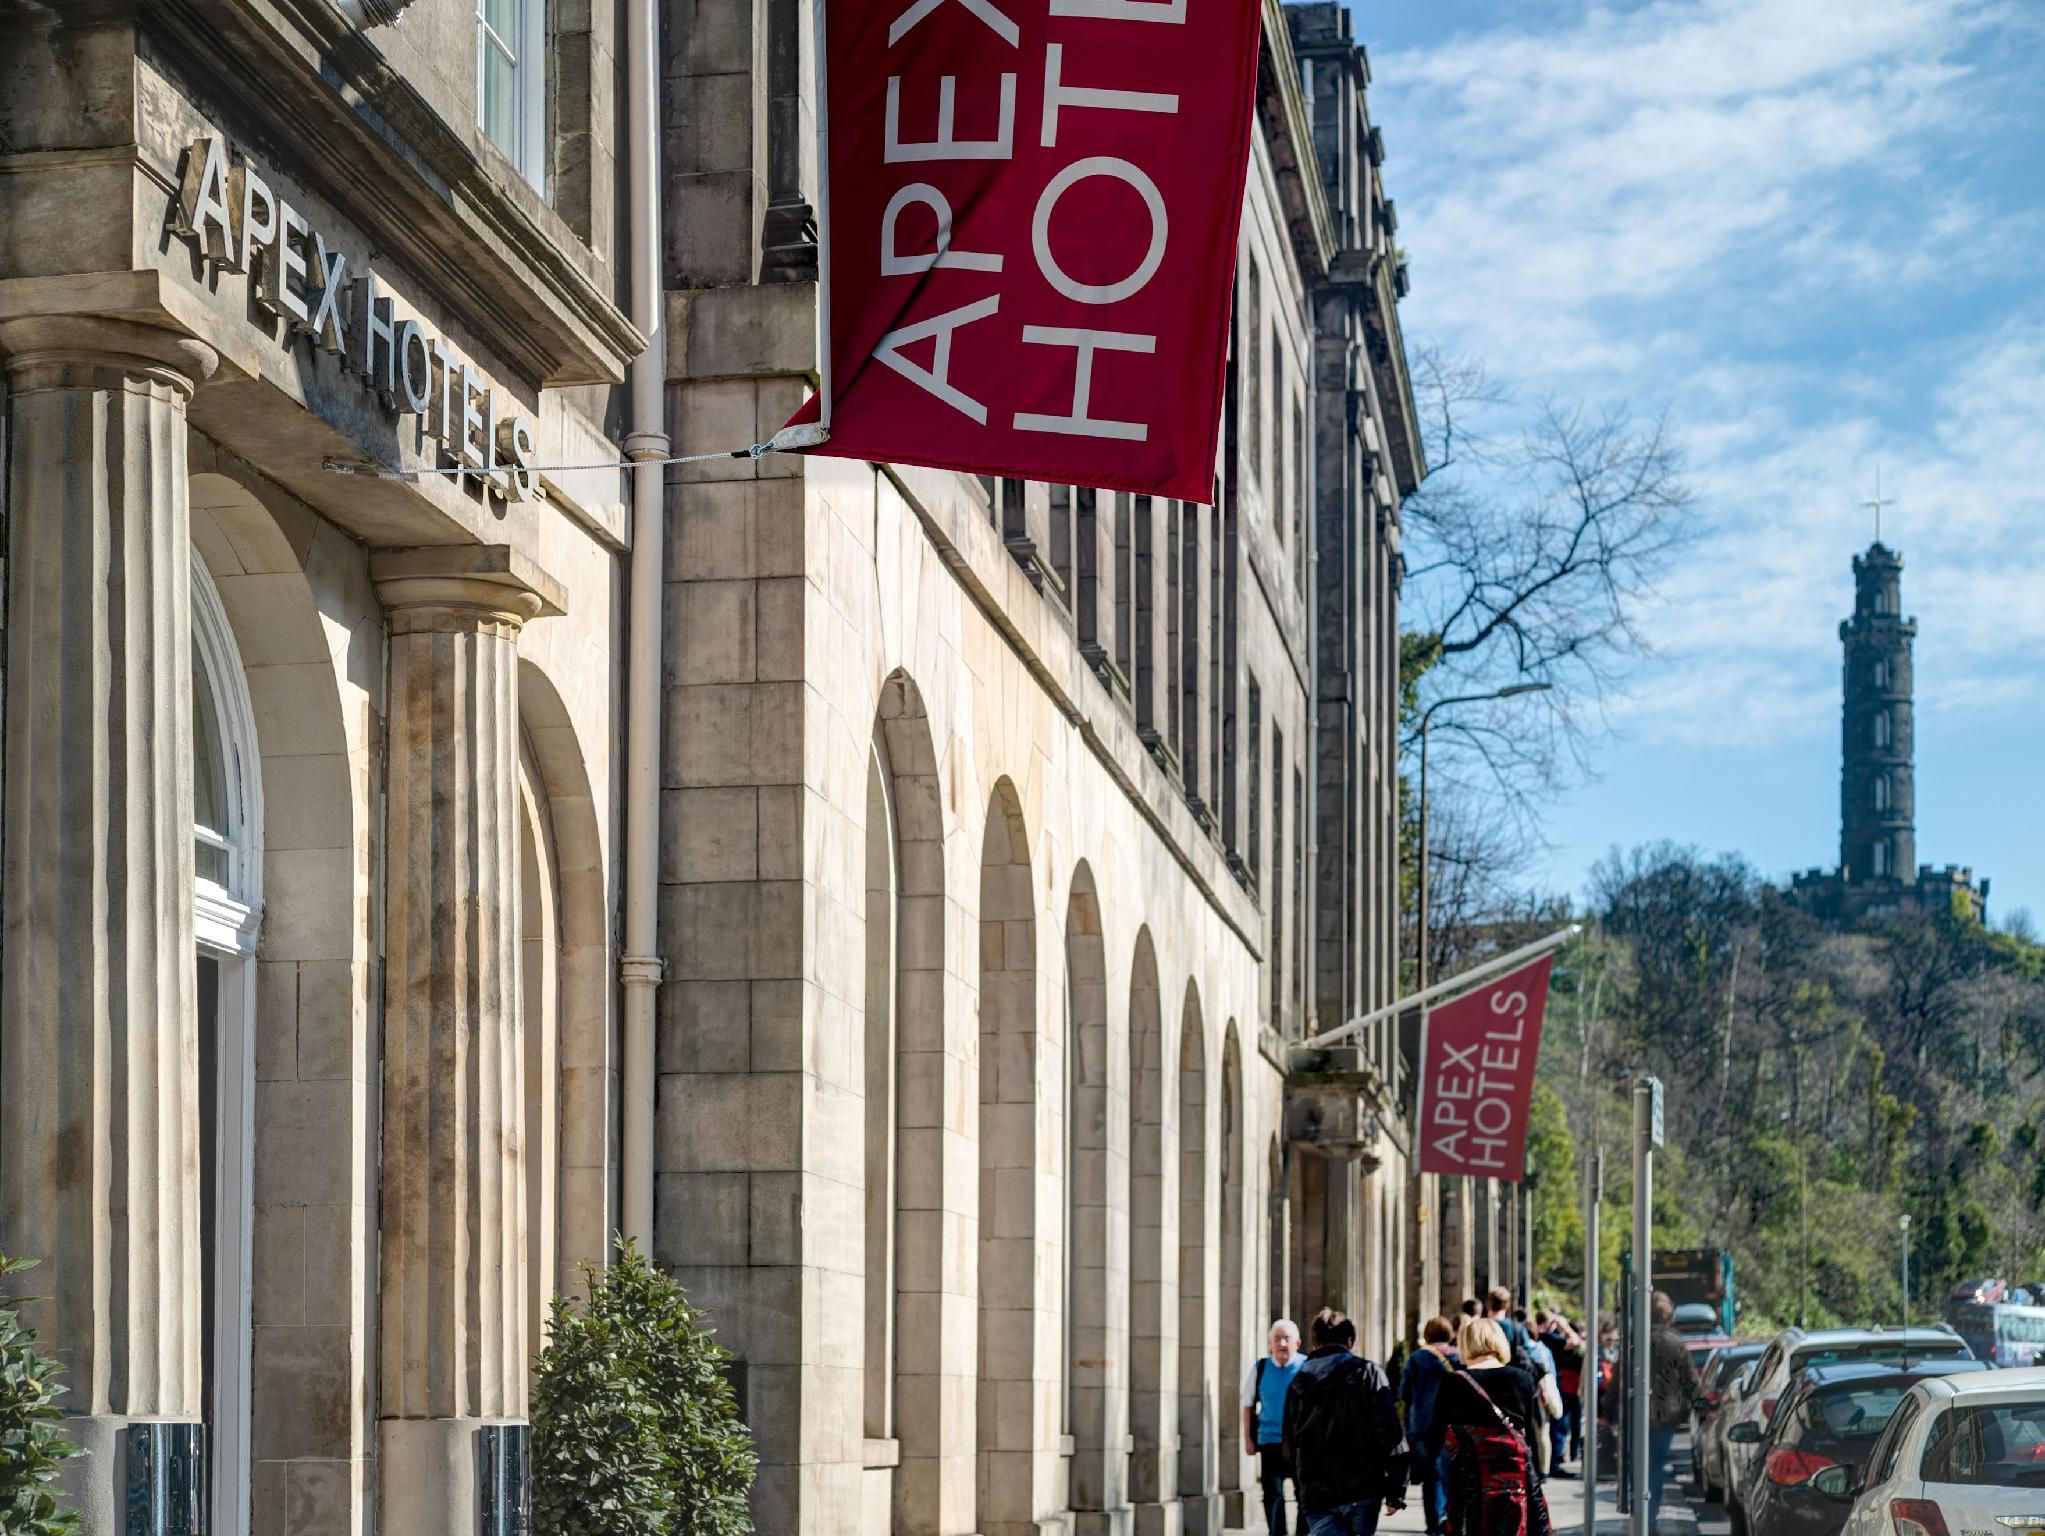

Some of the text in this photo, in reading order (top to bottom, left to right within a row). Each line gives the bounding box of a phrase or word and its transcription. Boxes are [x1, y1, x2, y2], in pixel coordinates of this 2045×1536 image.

[192, 137, 535, 503] APEX HOTELS
[1013, 0, 1188, 442] HOT
[1432, 1041, 1479, 1164] APEX
[1469, 990, 1528, 1168] HOTELS
